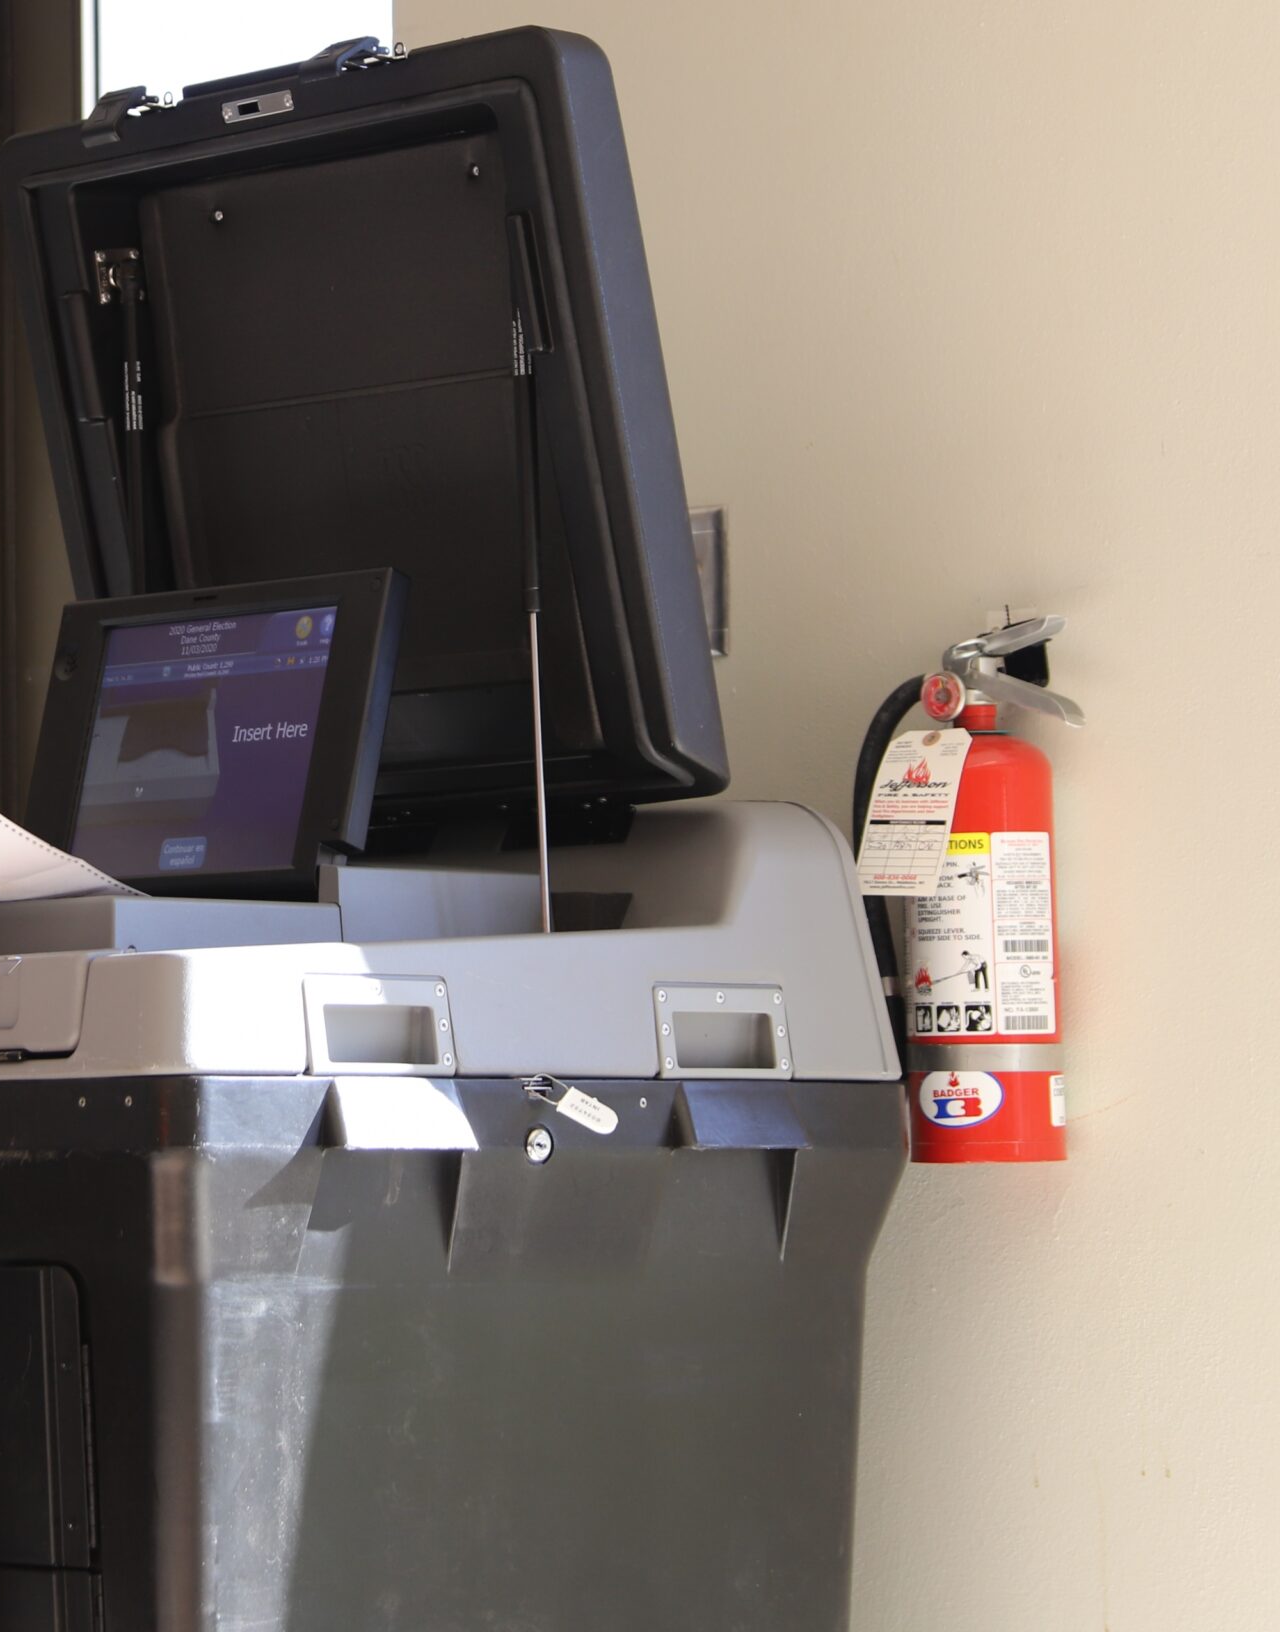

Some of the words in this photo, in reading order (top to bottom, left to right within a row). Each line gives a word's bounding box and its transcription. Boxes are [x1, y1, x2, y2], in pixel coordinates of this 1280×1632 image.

[169, 625, 186, 636] 2020
[186, 621, 212, 634] General
[212, 621, 236, 631] Election
[181, 635, 197, 645] Dane
[199, 633, 221, 643] County
[181, 643, 218, 656] 11/03/2020
[232, 723, 273, 742] Insert
[276, 721, 308, 739] Here
[879, 779, 951, 792] Jefferson
[949, 839, 984, 850] TIONS
[933, 1088, 979, 1098] BADGER
